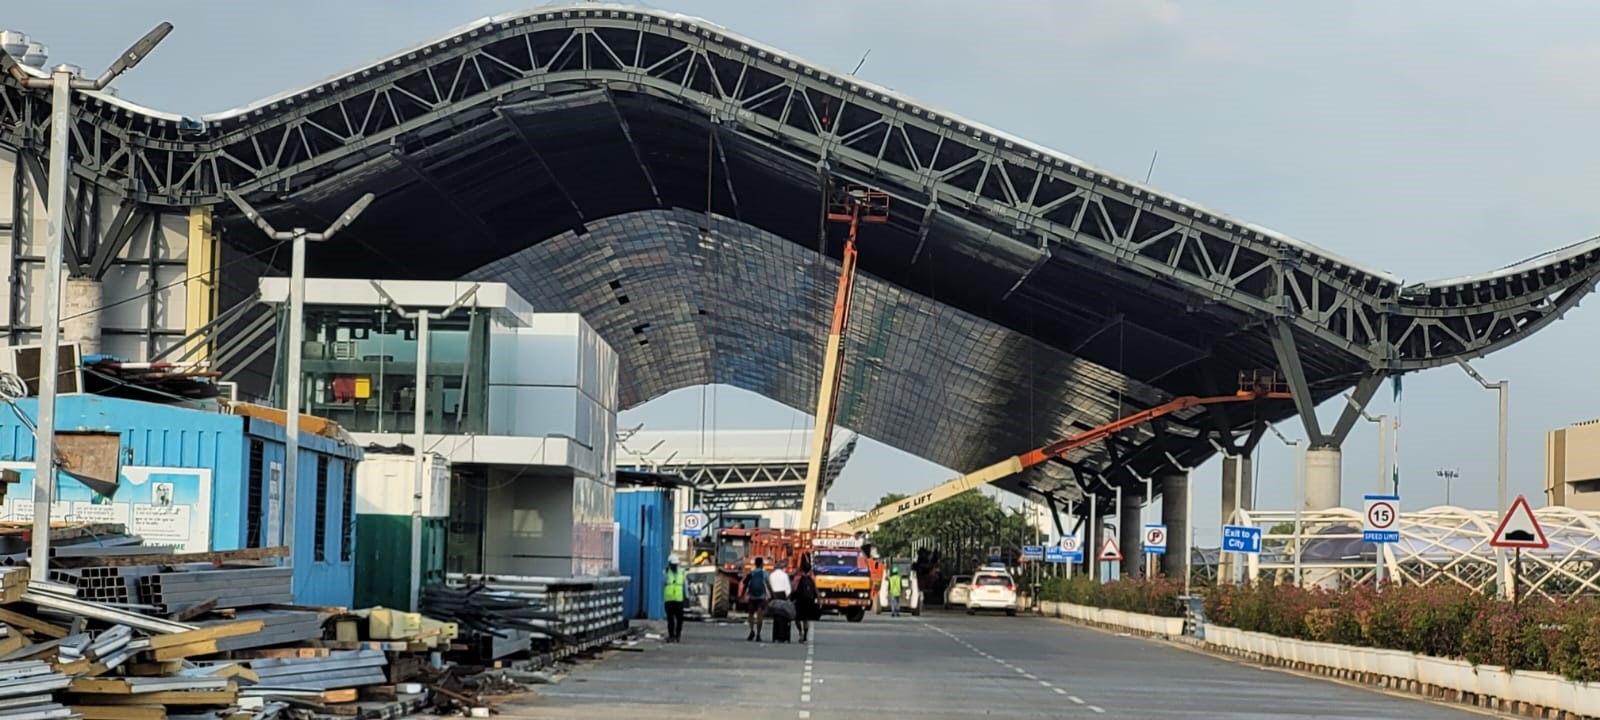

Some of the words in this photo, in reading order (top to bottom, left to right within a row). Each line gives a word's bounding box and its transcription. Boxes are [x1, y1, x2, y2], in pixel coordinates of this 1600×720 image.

[897, 501, 911, 513] JLG
[913, 493, 932, 506] LIFT
[1374, 510, 1389, 522] 15
[1225, 528, 1240, 538] Exit
[1241, 530, 1250, 538] to
[1365, 532, 1383, 540] SPEED
[1383, 533, 1398, 541] LIMIT
[1228, 538, 1245, 549] City
